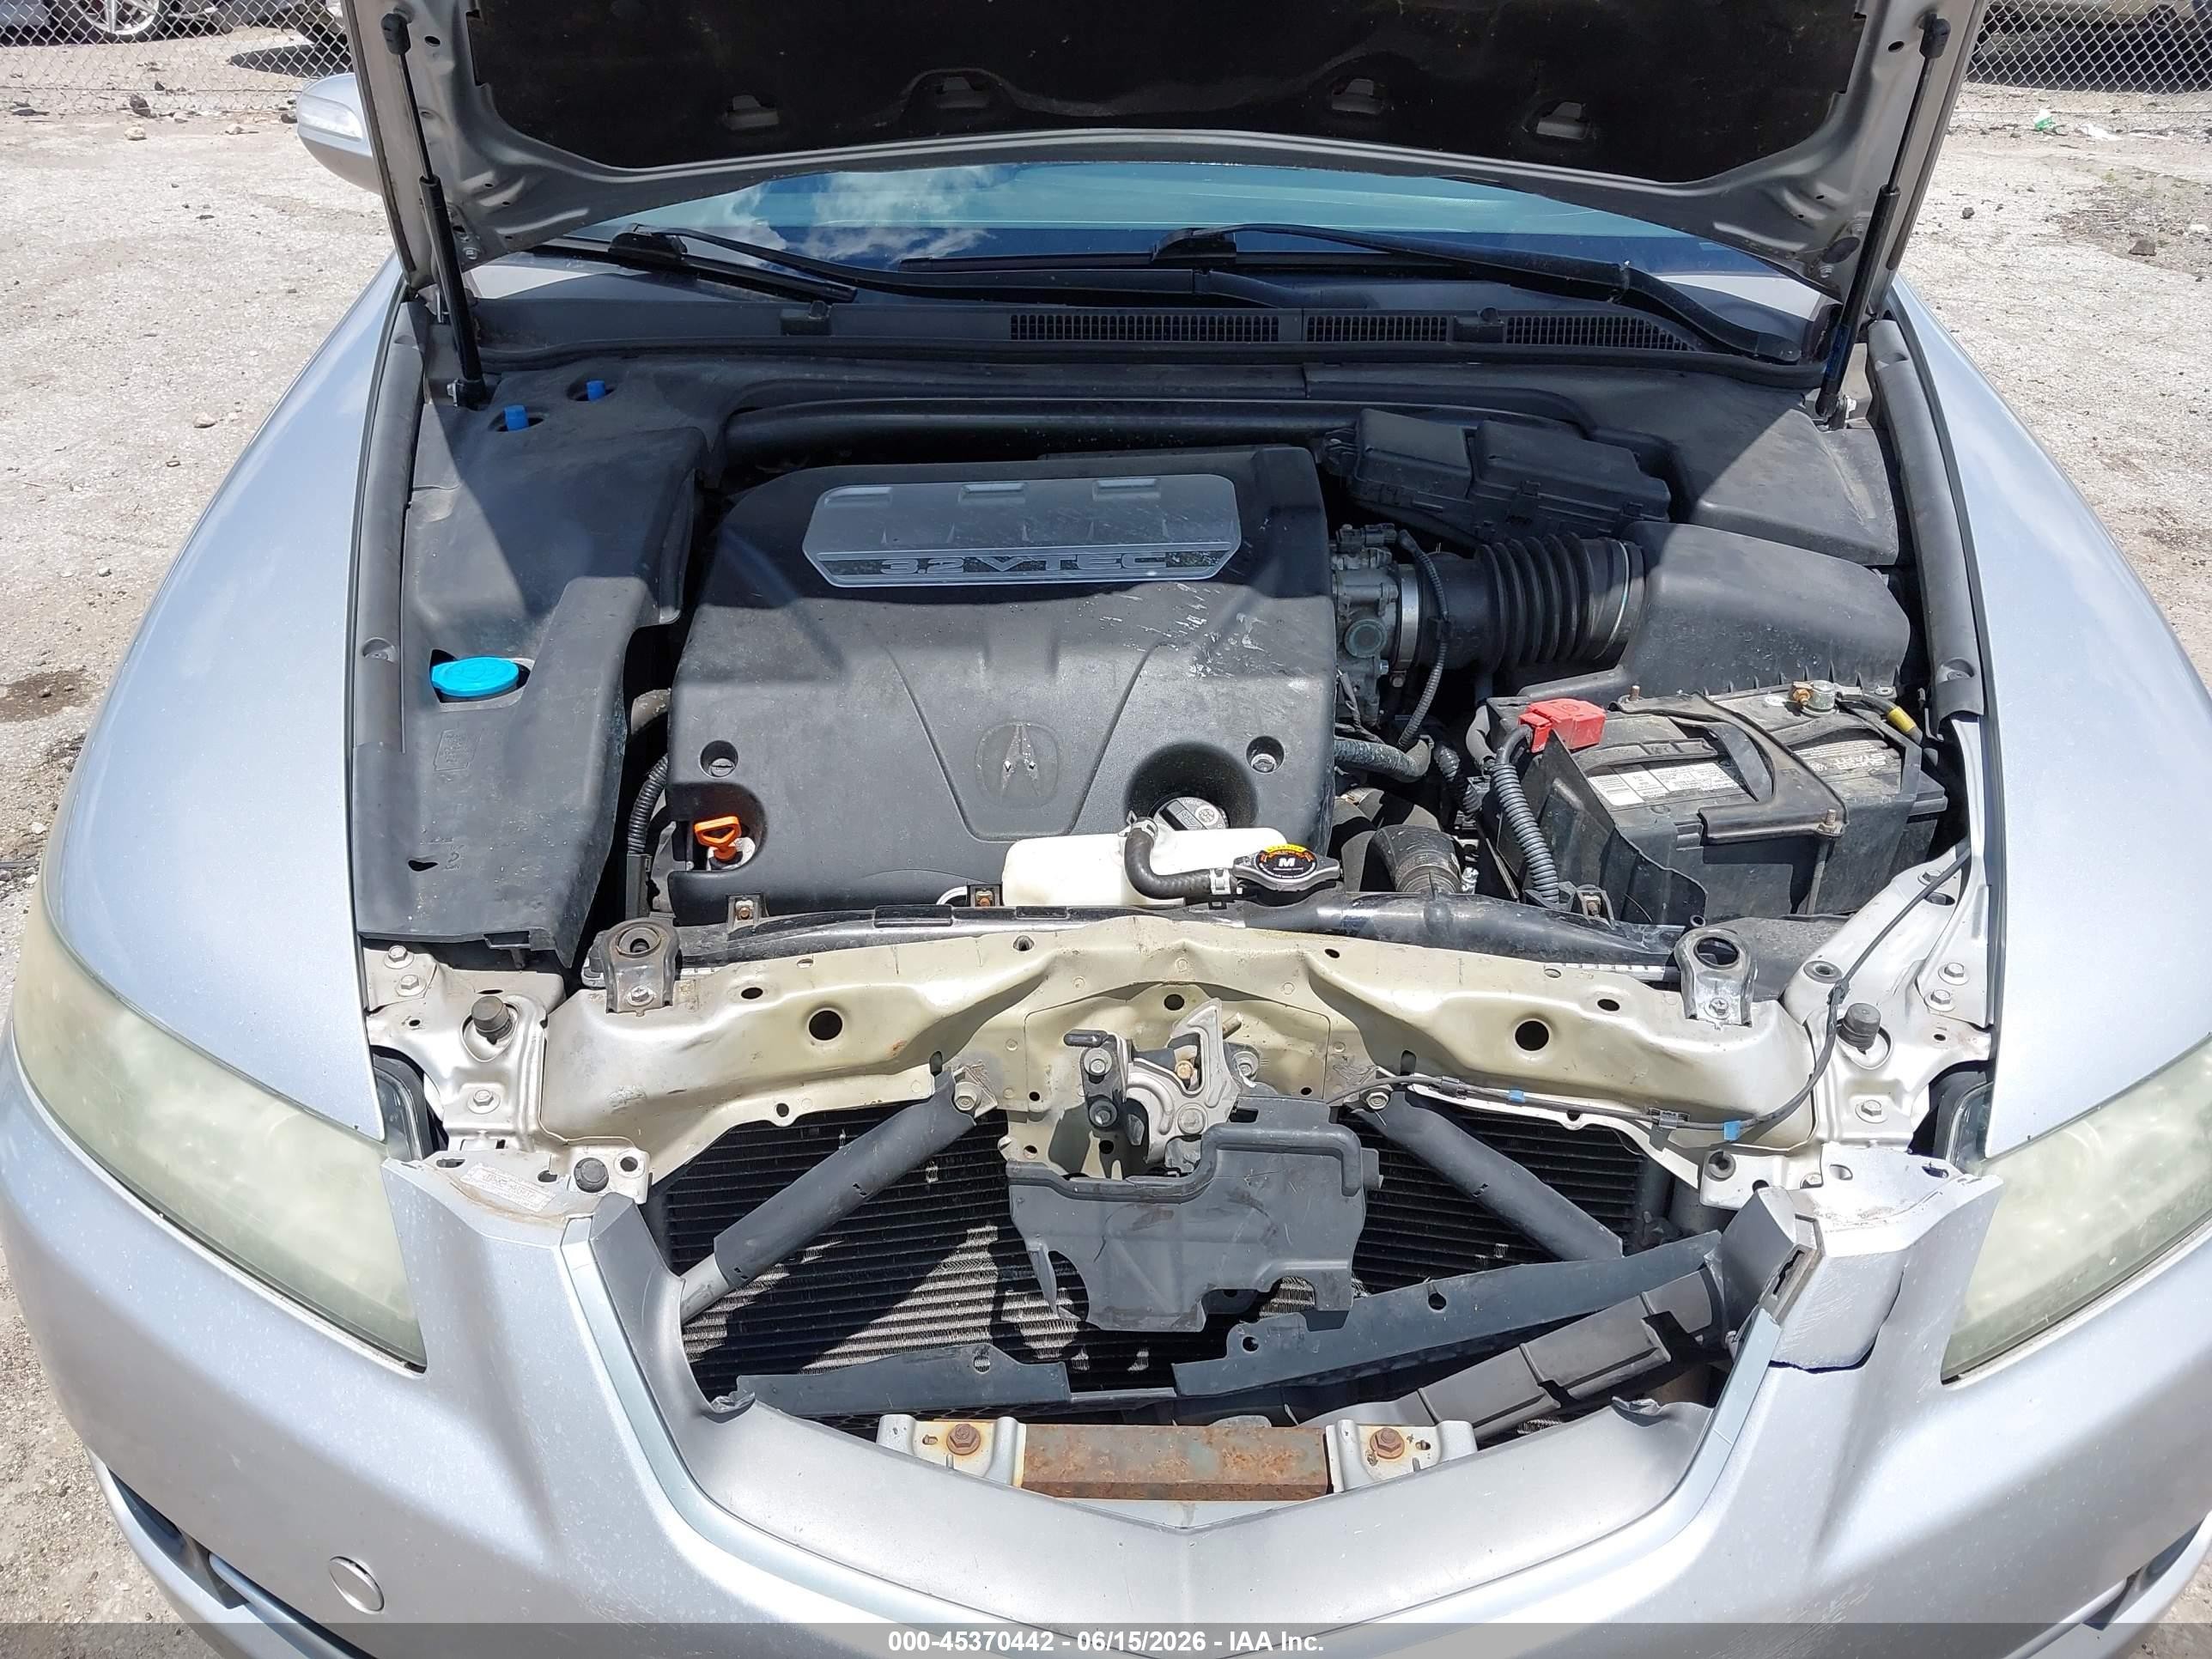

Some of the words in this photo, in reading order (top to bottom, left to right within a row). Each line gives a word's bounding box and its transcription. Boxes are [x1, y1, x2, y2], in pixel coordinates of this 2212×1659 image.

[879, 556, 965, 574] 3.2
[975, 552, 1167, 573] VTEC
[1278, 857, 1296, 867] M
